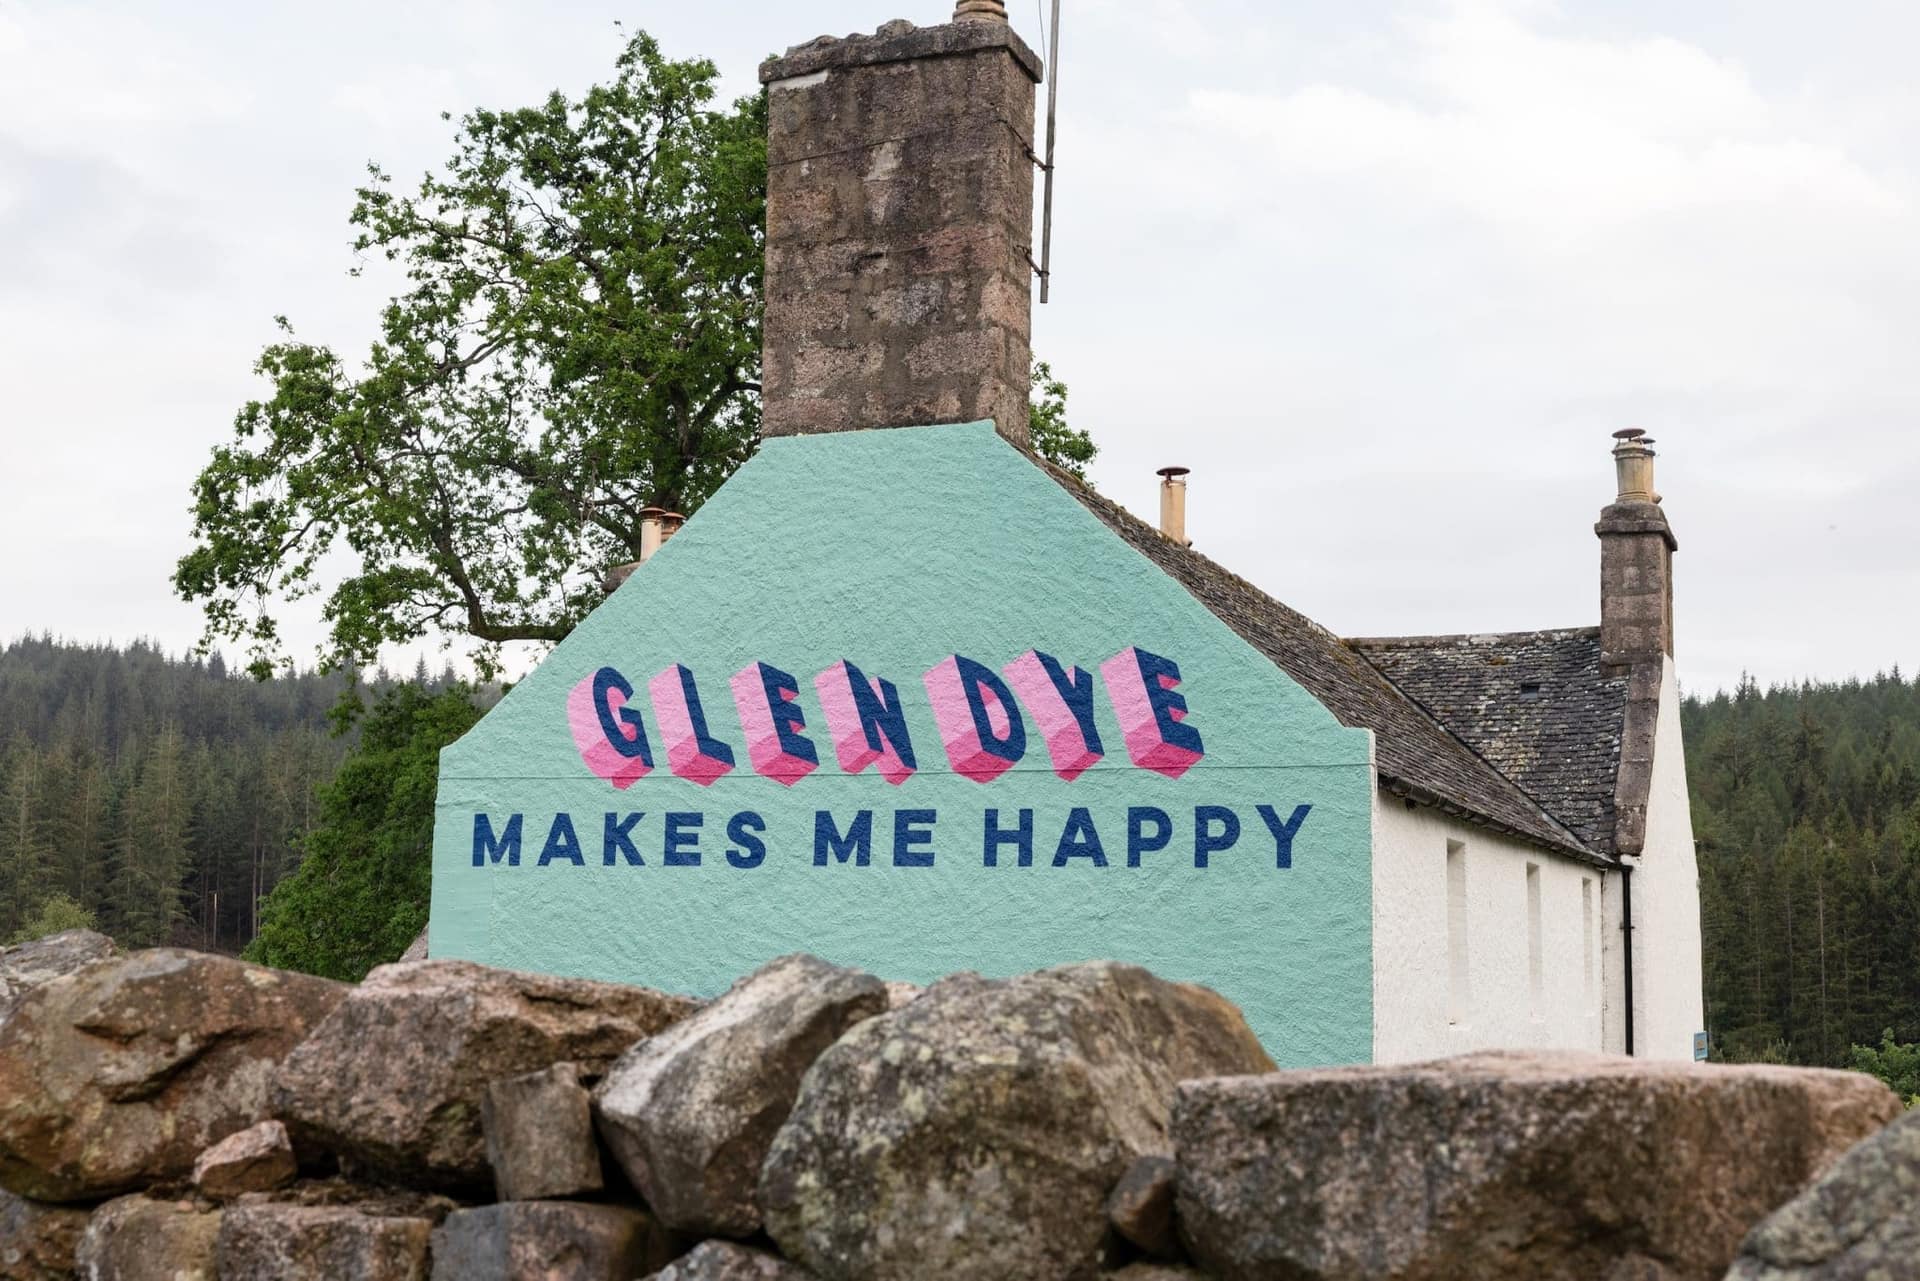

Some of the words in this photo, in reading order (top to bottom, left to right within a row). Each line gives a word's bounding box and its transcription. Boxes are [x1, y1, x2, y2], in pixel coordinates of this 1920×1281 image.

[472, 811, 767, 870] MAKES
[813, 809, 938, 868] ME
[984, 804, 1314, 870] HAPPY
